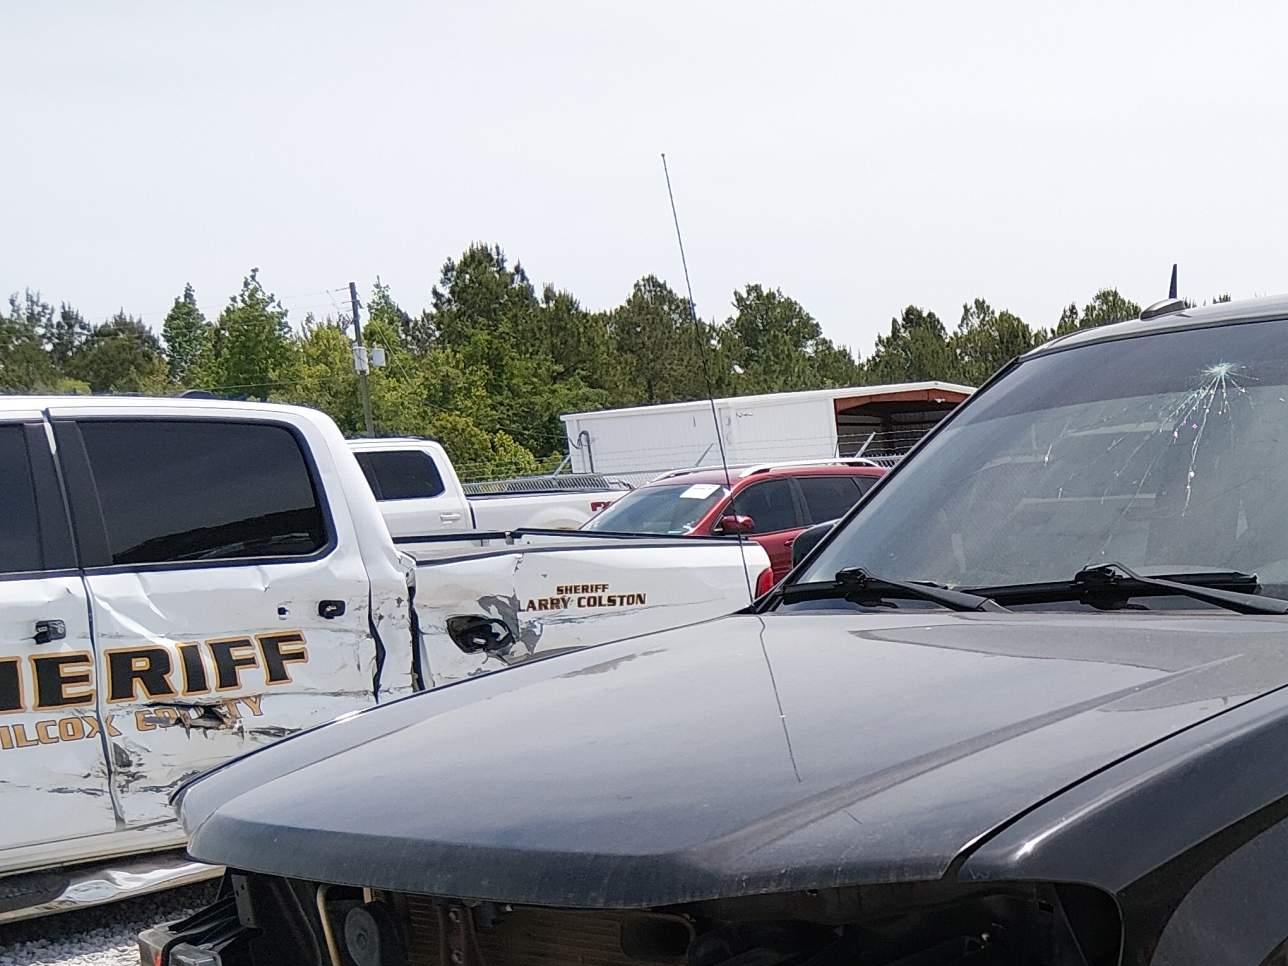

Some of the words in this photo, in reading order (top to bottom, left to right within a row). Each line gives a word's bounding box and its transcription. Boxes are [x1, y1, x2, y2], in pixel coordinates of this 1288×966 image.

[556, 583, 609, 595] SHERIFF
[518, 597, 571, 612] LARRY
[577, 593, 646, 608] COLSTON
[0, 714, 122, 749] ILCOX
